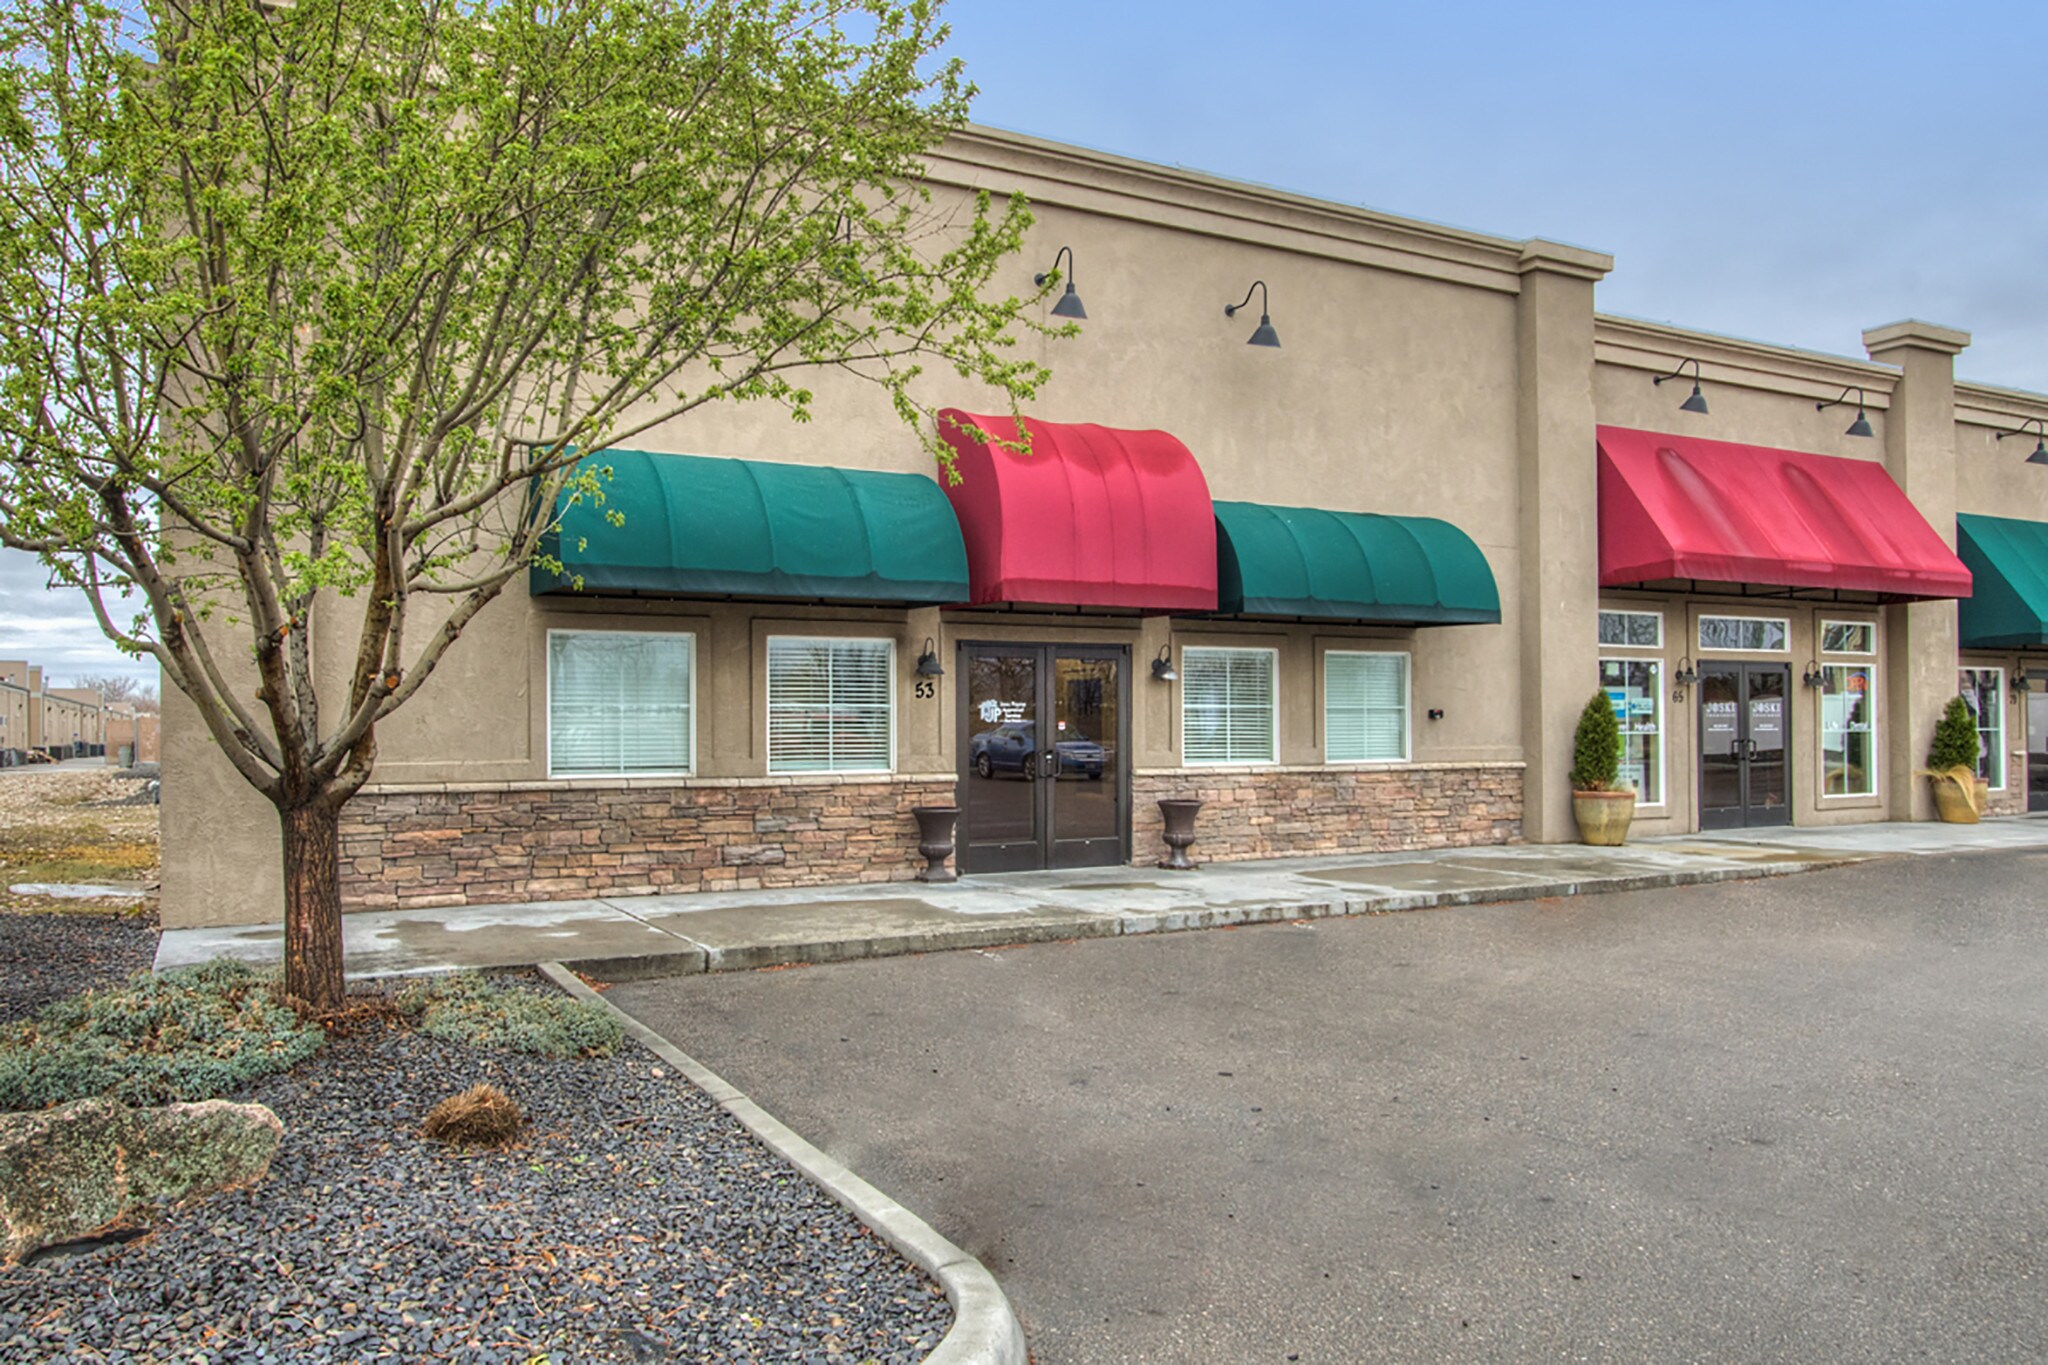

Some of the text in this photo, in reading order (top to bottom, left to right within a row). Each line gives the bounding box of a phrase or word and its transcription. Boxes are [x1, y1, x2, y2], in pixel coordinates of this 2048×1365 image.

[915, 681, 935, 699] 53
[1672, 690, 1684, 704] 65
[1752, 702, 1781, 713] JOSKI
